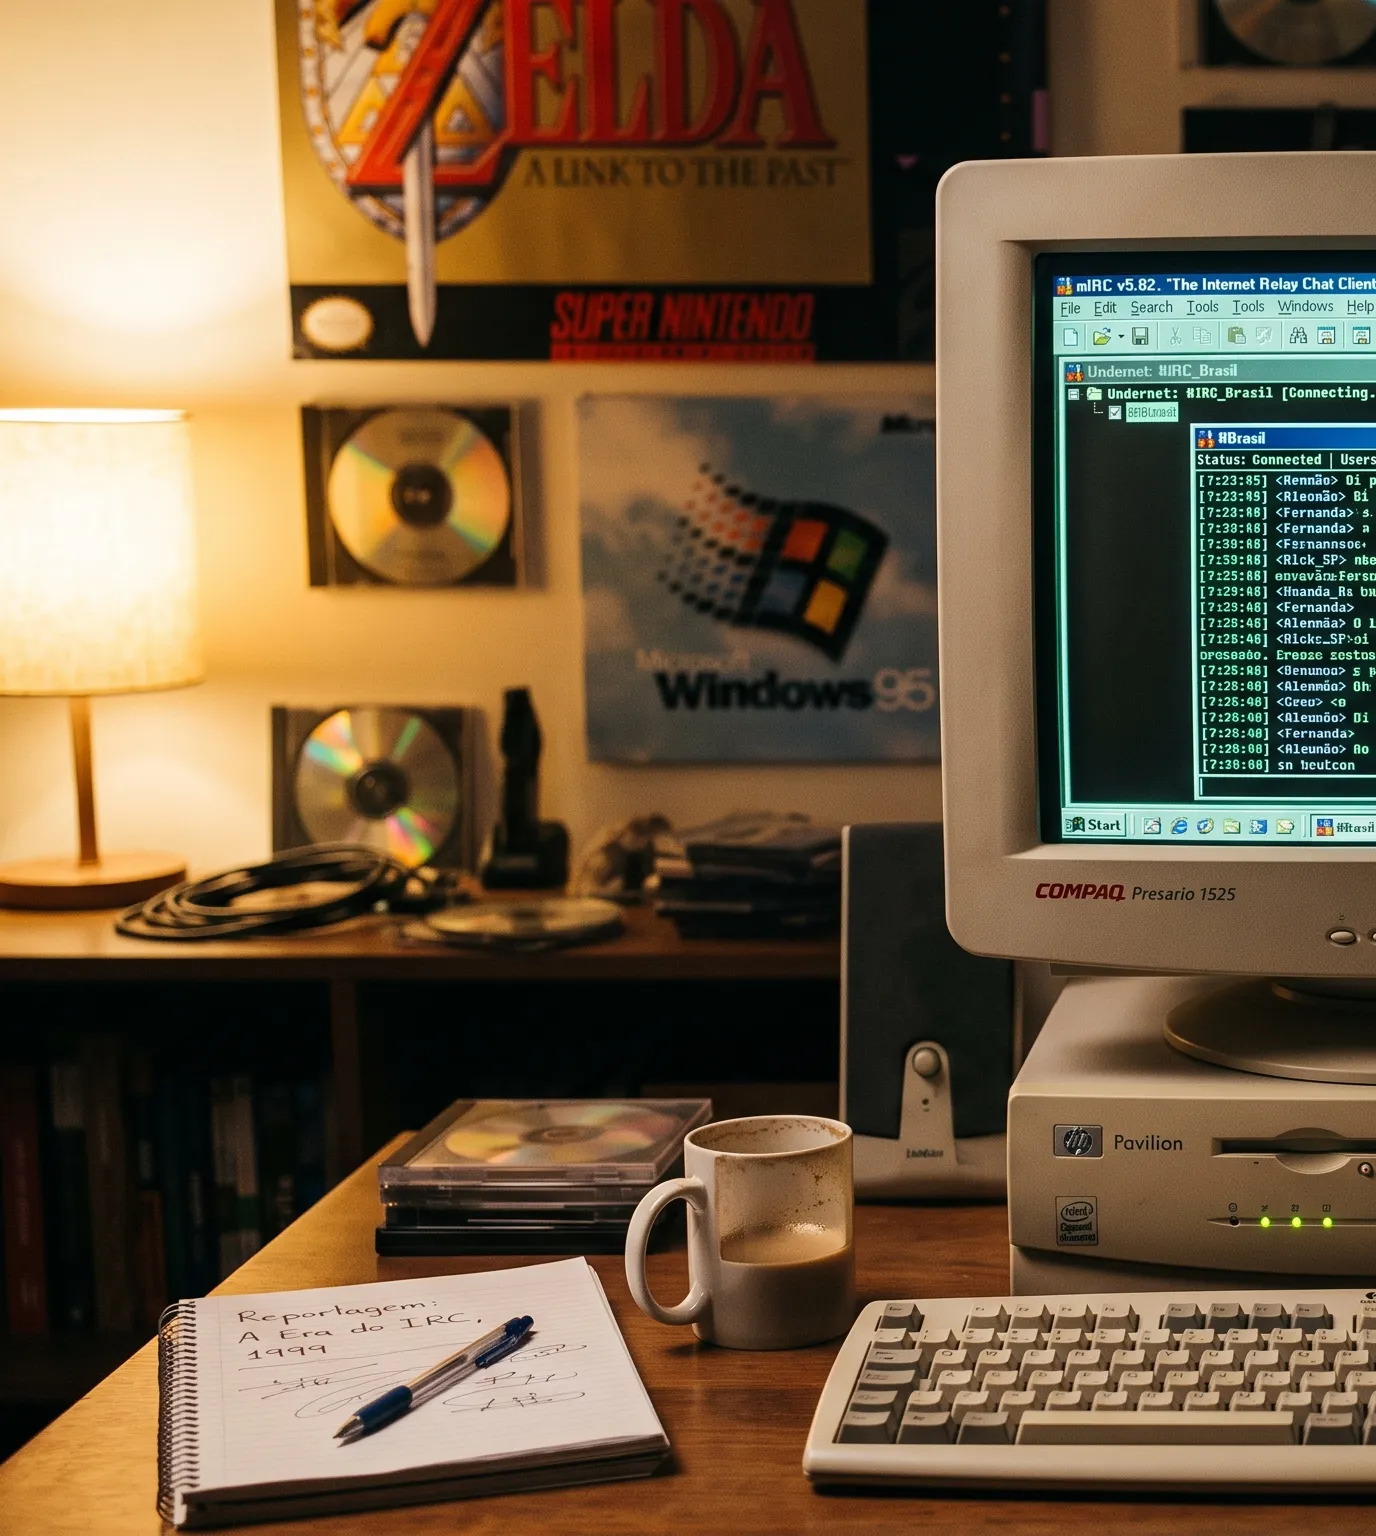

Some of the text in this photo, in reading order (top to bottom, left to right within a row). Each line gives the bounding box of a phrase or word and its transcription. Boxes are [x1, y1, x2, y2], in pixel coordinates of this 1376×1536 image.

[346, 0, 838, 186] ZELDA
[523, 156, 848, 188] A LINK TO THE PAST
[1077, 279, 1112, 292] mIRC
[1203, 278, 1256, 290] Internet
[1260, 278, 1299, 293] Relay
[1303, 277, 1334, 290] Chat
[552, 292, 815, 340] SUPER NINTENDO
[1061, 299, 1375, 317] File Edit Search Tools Tools Windows Help
[1088, 365, 1153, 378] Undernet:
[1108, 387, 1178, 400] Undernet:
[1186, 386, 1273, 401] #IRC_Brasil
[1218, 432, 1266, 445] #Brasil
[1197, 454, 1246, 466] Status:
[1252, 454, 1322, 466] Connected
[1276, 507, 1354, 518] <Fernanda>
[1276, 522, 1355, 534] <Fernanda>
[1276, 602, 1355, 613] <Fernanda>
[654, 667, 937, 713] Windows 95
[1276, 728, 1355, 739] <Fernanda>
[1088, 818, 1121, 831] Start
[1034, 883, 1236, 902] COMPAQ Presario 1525
[1114, 1134, 1183, 1151] Pavilion
[237, 1301, 438, 1326] Reportagem:
[238, 1331, 260, 1344] A
[279, 1327, 333, 1341] Era
[349, 1322, 384, 1335] do
[247, 1344, 328, 1361] 1999
